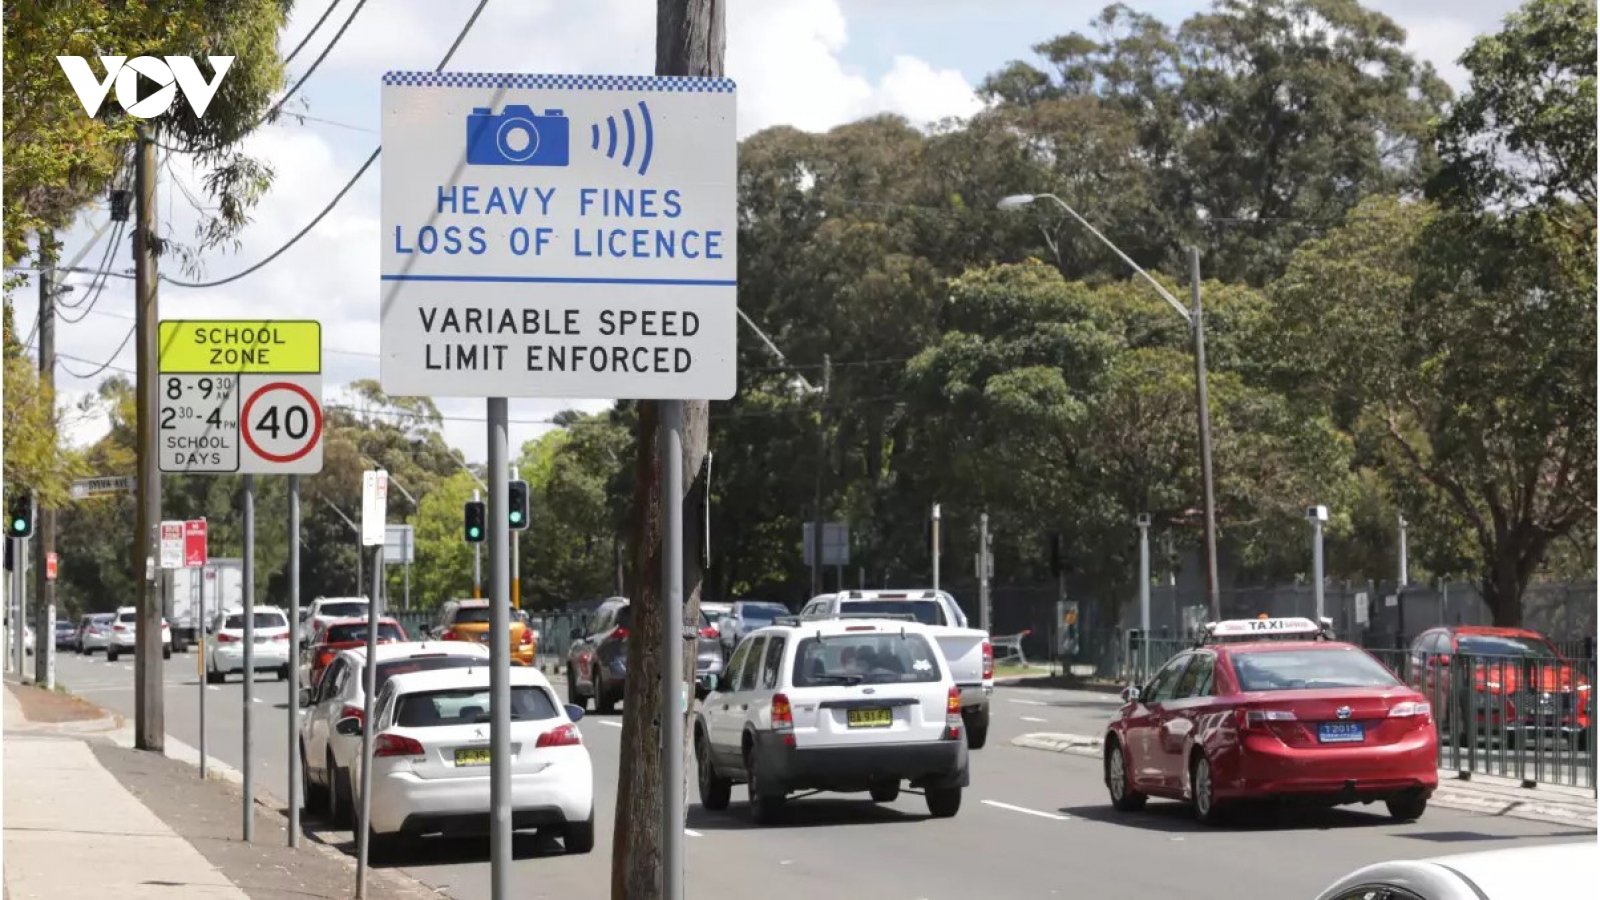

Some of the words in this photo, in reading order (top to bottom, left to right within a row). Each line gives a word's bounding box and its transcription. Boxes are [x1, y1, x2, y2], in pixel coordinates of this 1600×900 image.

[437, 186, 556, 215] HEAVY
[580, 188, 682, 217] FINES
[395, 225, 487, 255] LOSS
[509, 227, 553, 256] OF
[574, 229, 723, 259] LICENCE
[419, 307, 581, 334] VARIABLE
[598, 309, 700, 336] SPEED
[194, 328, 286, 344] SCHOOL
[209, 348, 270, 364] ZONE
[425, 344, 508, 370] LIMIT
[526, 345, 692, 373] ENFORCED
[255, 405, 309, 440] 40
[167, 436, 230, 449] SCHOOL
[174, 452, 221, 465] DAYS
[1248, 620, 1284, 631] TAXI
